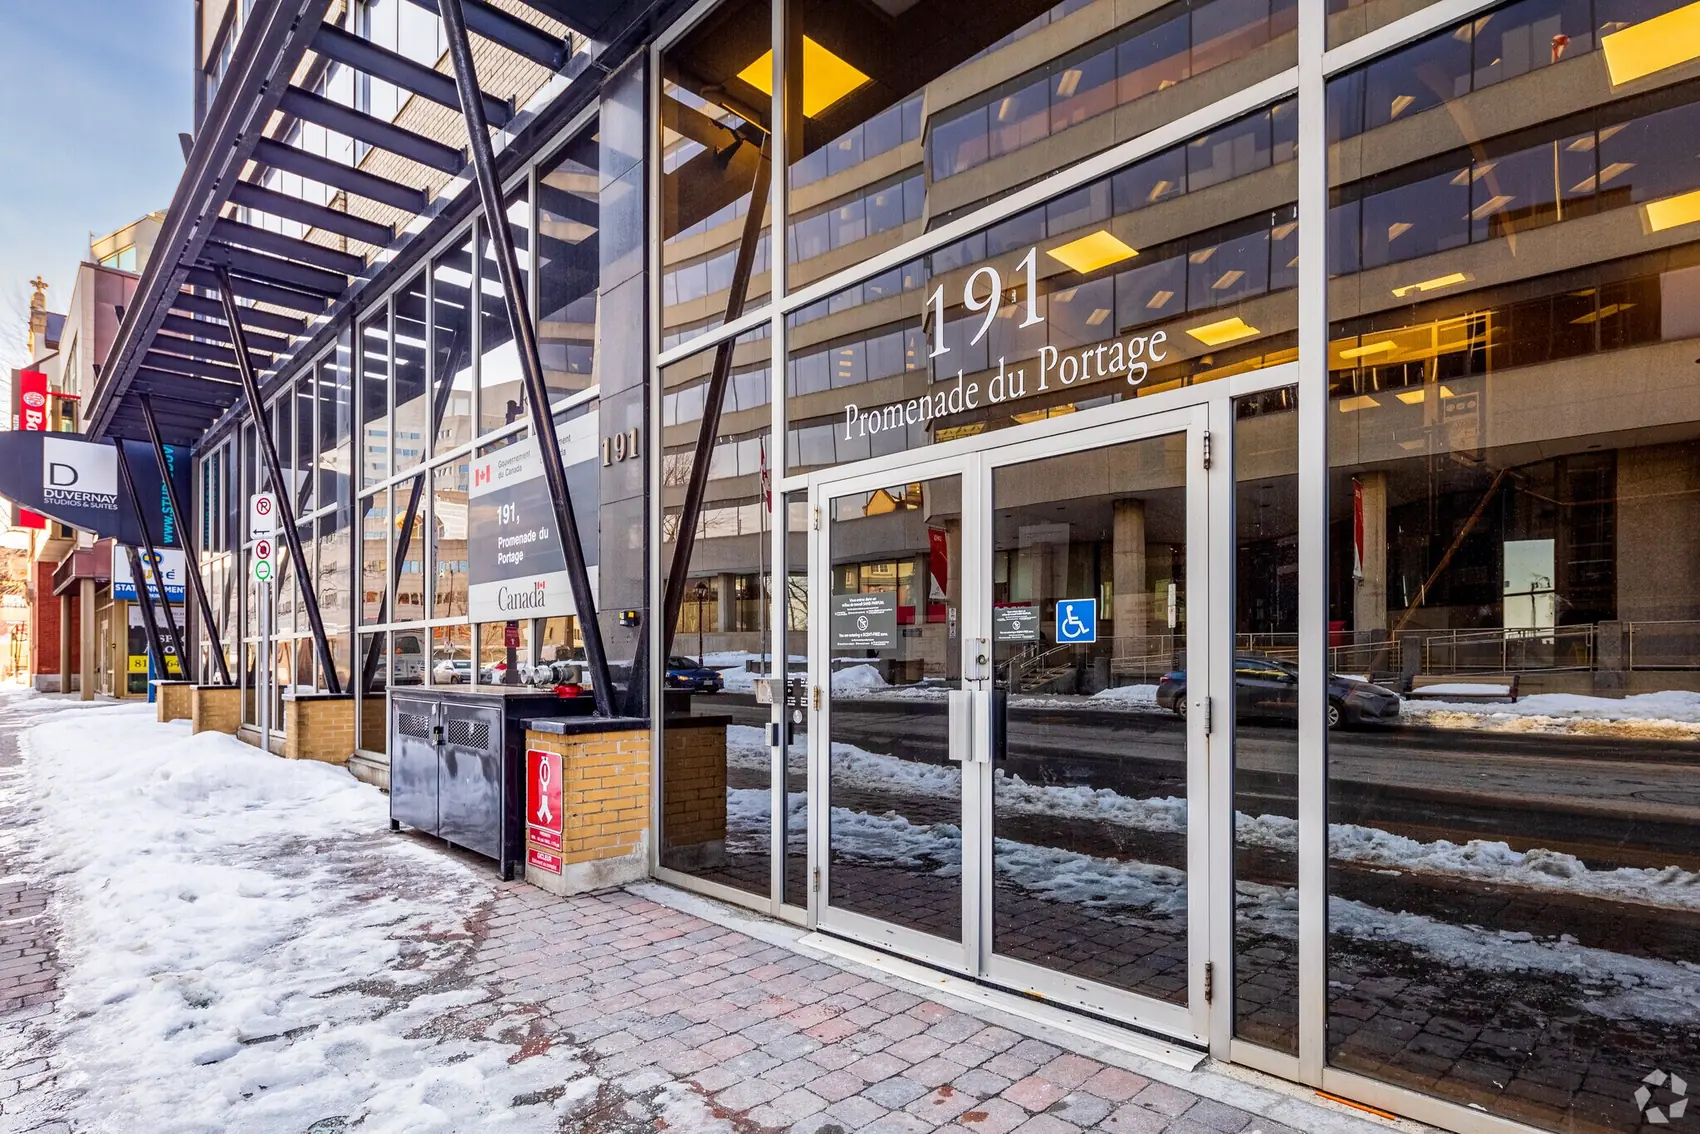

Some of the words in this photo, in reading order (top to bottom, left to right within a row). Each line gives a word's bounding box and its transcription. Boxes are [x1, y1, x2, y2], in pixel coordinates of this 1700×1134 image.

[926, 247, 1044, 358] 191
[844, 368, 979, 441] Promenade
[988, 356, 1027, 403] du
[1037, 330, 1167, 385] Portage
[601, 427, 640, 467] 191
[498, 450, 531, 469] Gouvernement
[50, 462, 78, 486] D
[498, 471, 504, 479] du
[505, 465, 522, 477] Canada
[44, 489, 117, 504] DUVERNAY
[44, 498, 81, 507] STUDIOS
[90, 502, 118, 510] SUITES
[497, 501, 520, 526] 191,
[498, 529, 536, 549] Promenade
[539, 526, 549, 540] du
[498, 550, 524, 565] Portage
[498, 581, 545, 611] Canada
